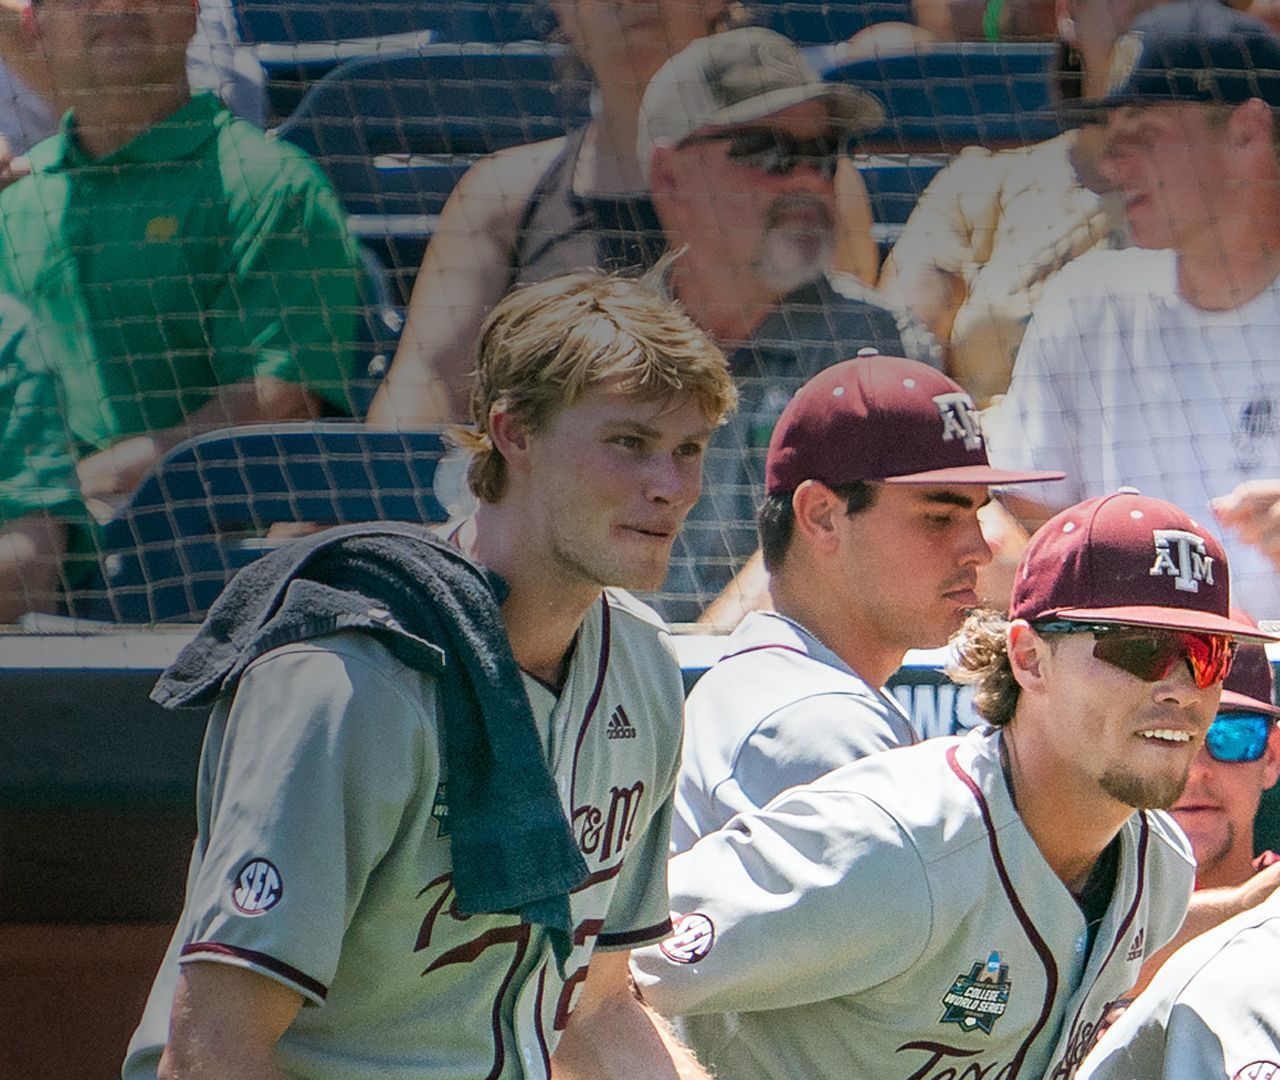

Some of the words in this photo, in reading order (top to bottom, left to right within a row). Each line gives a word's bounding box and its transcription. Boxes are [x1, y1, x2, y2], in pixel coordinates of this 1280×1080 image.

[234, 861, 281, 911] SEC
[944, 993, 980, 1011] WORLD
[977, 1000, 1006, 1015] SERIES
[964, 986, 999, 1002] COLLEGE
